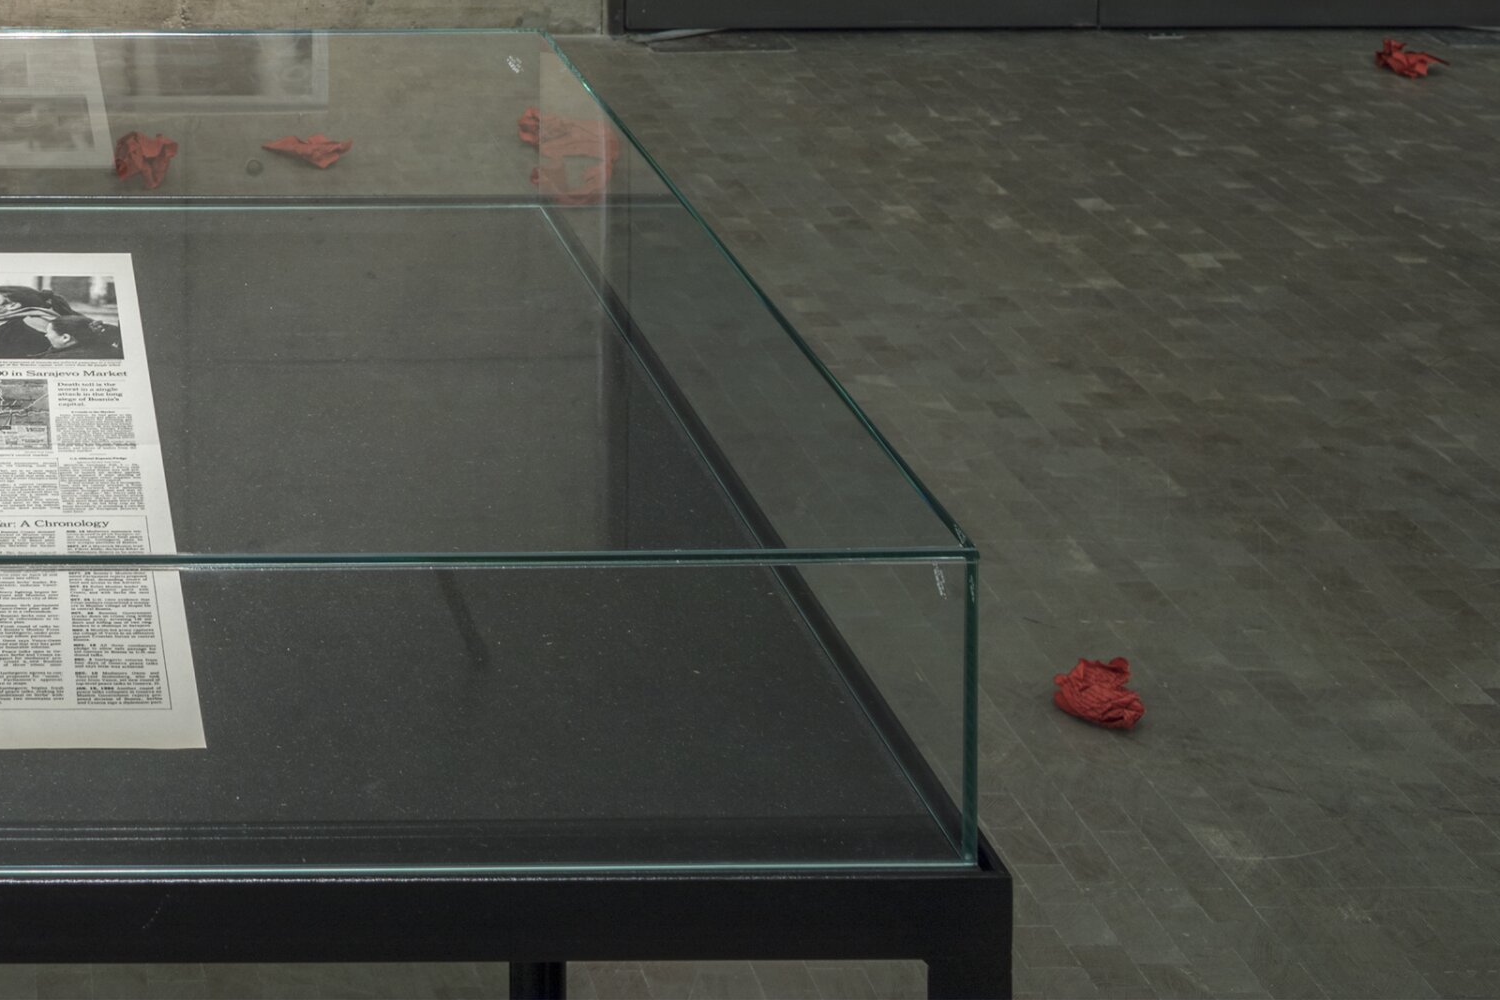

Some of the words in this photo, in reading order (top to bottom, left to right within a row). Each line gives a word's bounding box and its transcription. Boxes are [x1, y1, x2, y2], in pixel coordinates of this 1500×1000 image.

[26, 370, 80, 378] Sarajevo
[19, 520, 31, 528] A
[34, 520, 110, 529] Chronology
